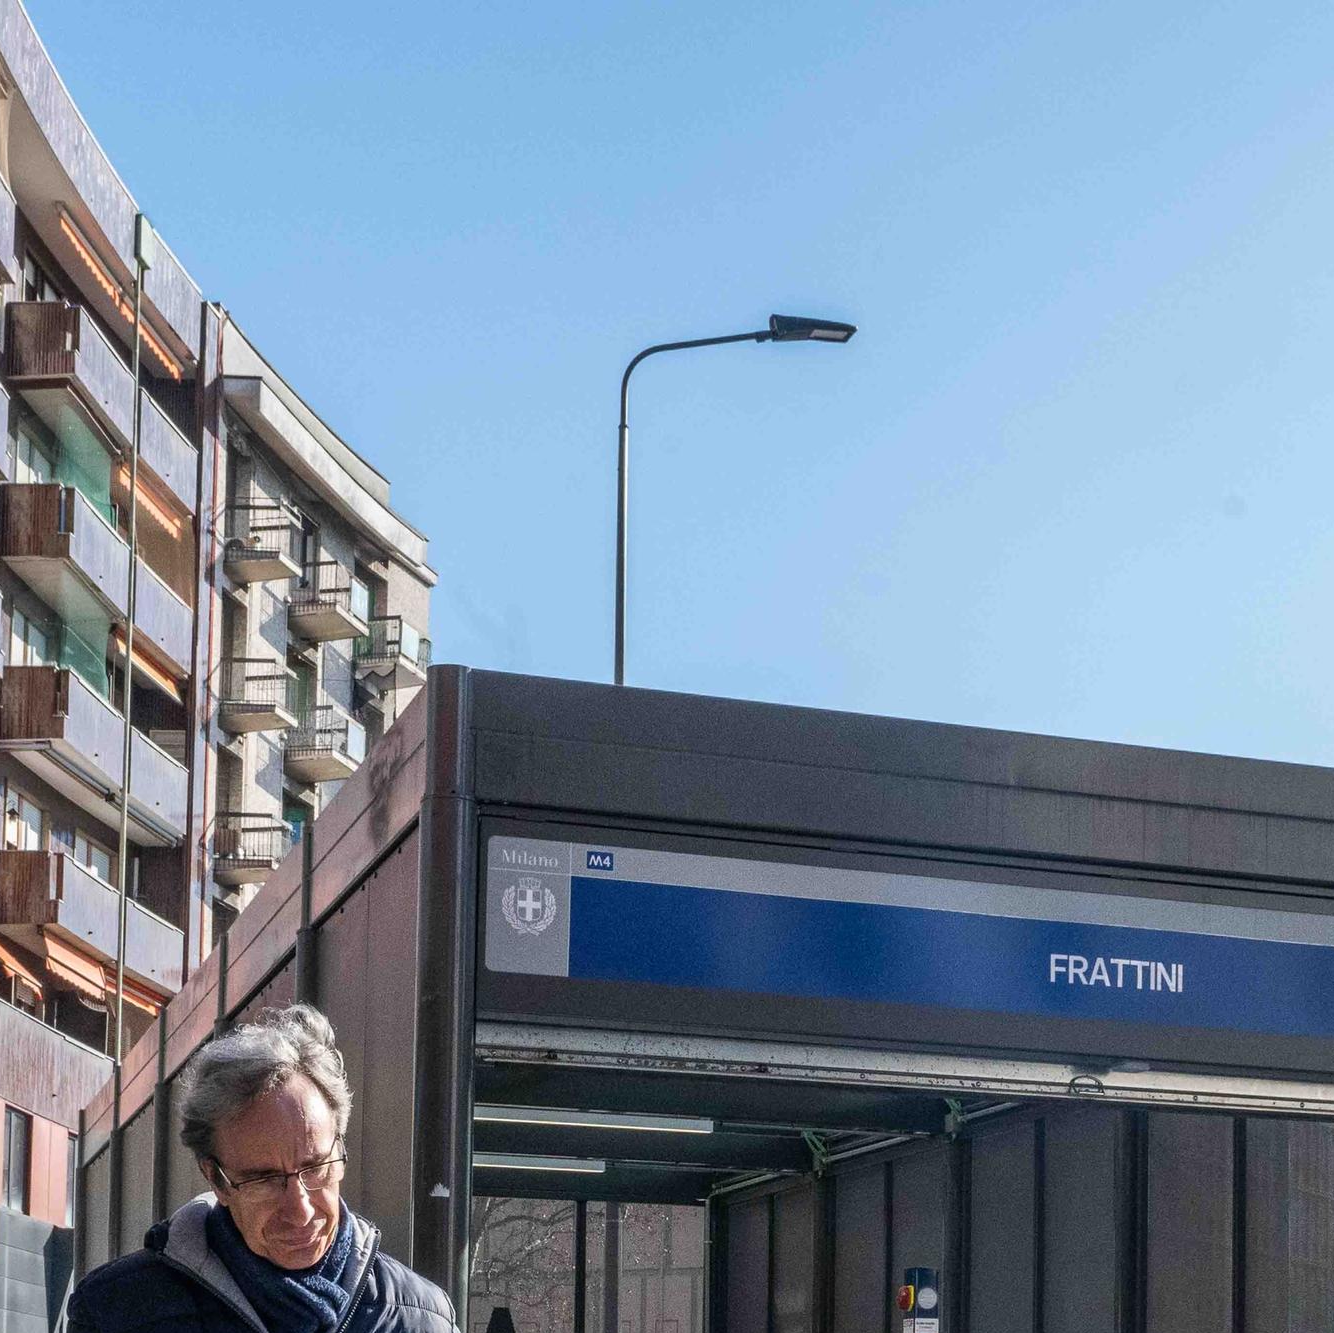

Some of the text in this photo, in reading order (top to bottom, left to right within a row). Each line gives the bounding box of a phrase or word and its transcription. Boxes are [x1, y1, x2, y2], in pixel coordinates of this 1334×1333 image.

[502, 849, 559, 868] Milano
[588, 854, 611, 868] M4
[1049, 953, 1184, 993] FRATTINI
